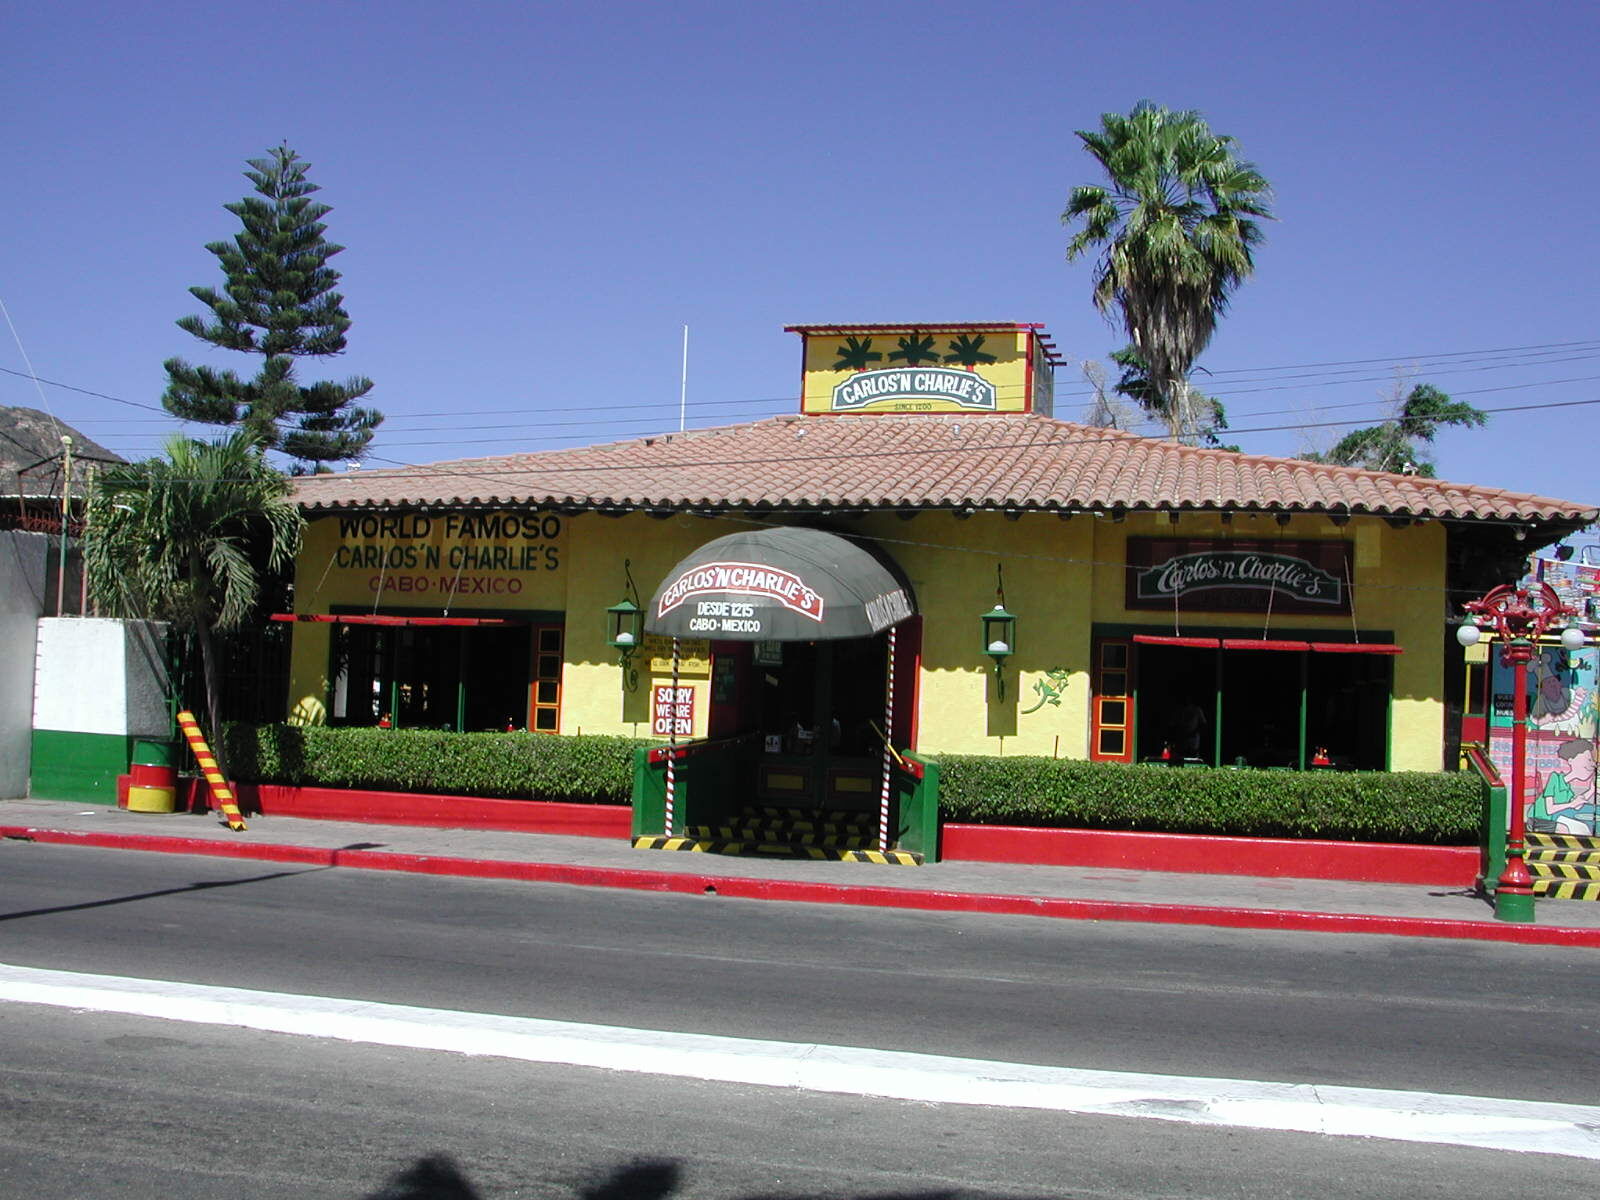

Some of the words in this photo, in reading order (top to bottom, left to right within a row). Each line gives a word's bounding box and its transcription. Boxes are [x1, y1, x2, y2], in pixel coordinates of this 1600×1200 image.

[842, 373, 911, 404] CARLOS'N
[915, 373, 986, 403] CHARLIE'S
[895, 403, 913, 411] SINCE
[339, 515, 431, 539] WORLD
[446, 516, 561, 540] FAMOSO
[336, 543, 440, 570] CARLOS'N
[449, 544, 559, 571] CHARLIE'S
[664, 566, 731, 606] CARLOS'N
[731, 568, 816, 609] CHARLIE'S
[697, 602, 730, 616] DESDE
[730, 603, 754, 617] 1215
[656, 703, 671, 717] WE
[655, 718, 692, 734] OPEN
